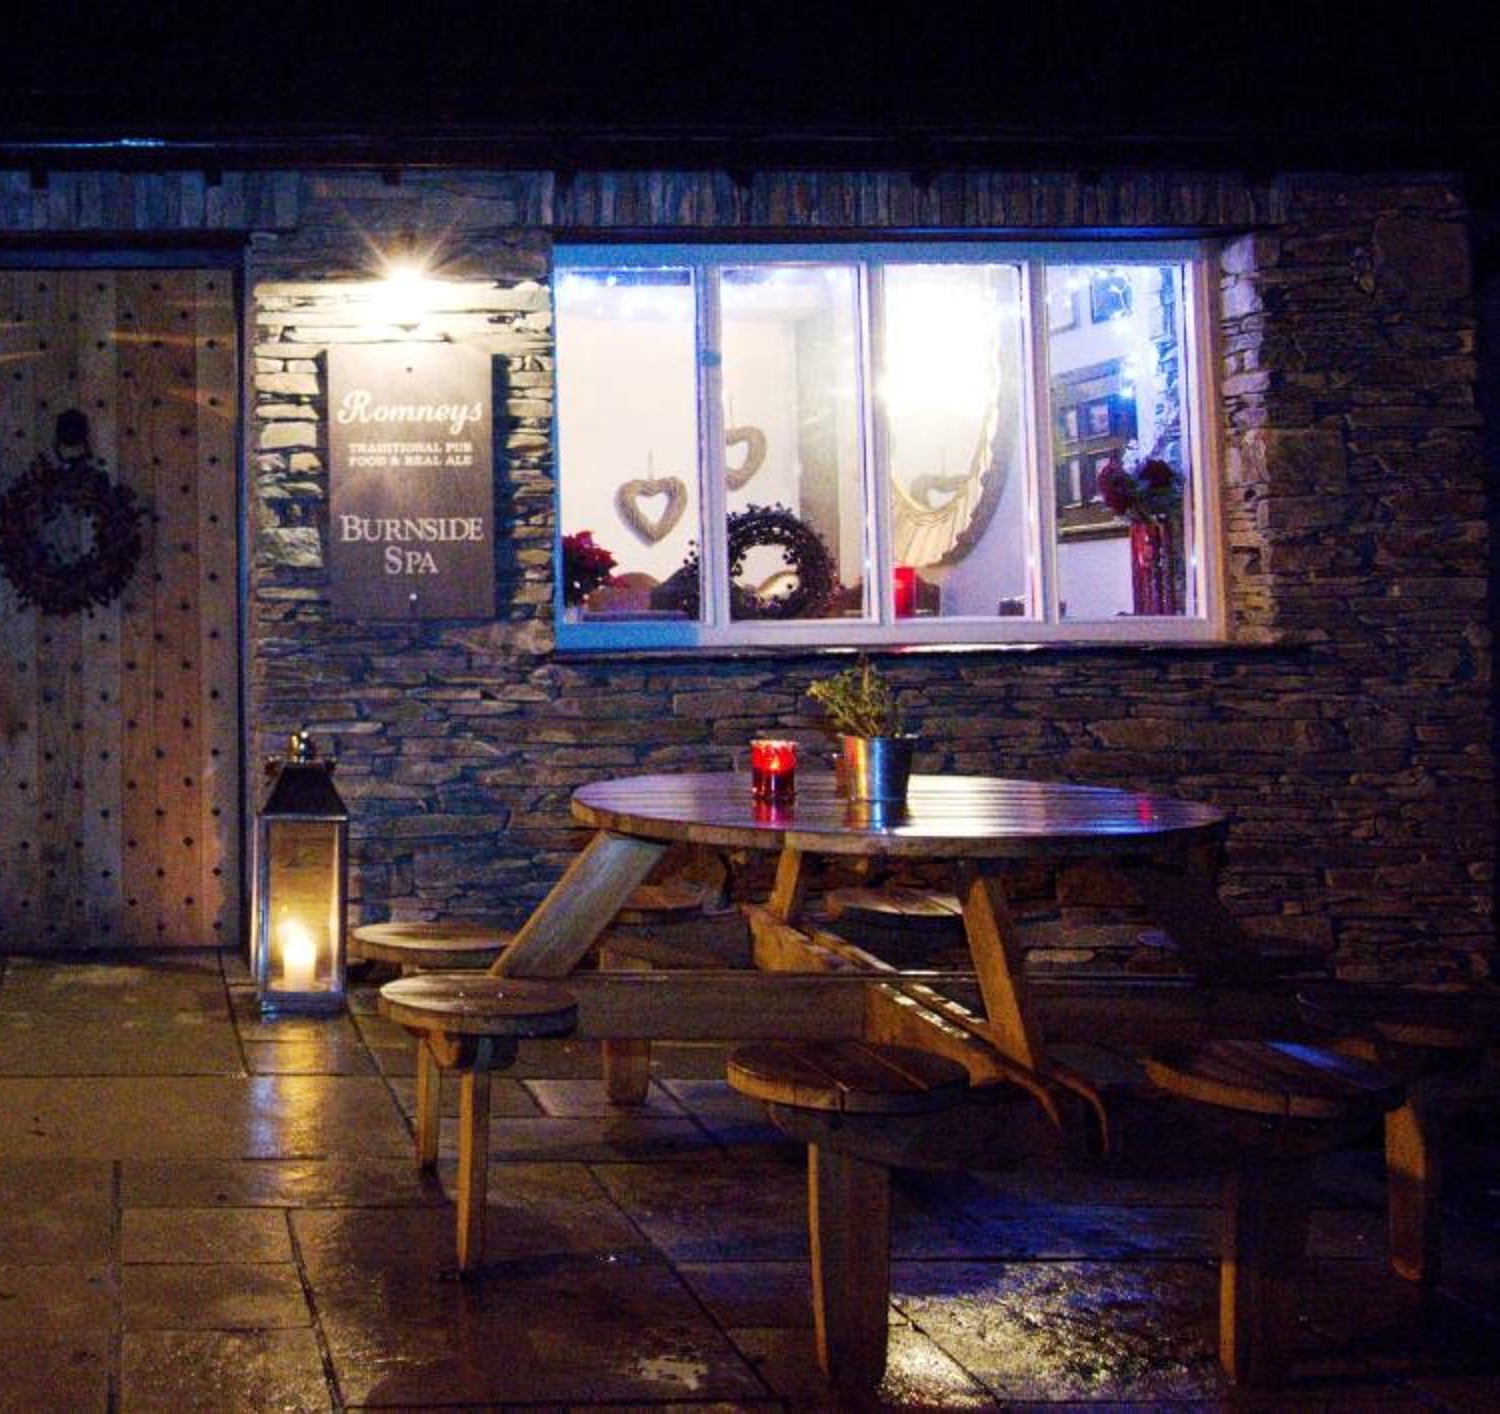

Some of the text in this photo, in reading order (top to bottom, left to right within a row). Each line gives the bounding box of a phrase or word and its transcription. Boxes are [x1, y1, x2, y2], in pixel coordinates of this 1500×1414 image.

[337, 390, 483, 434] Romneys
[348, 442, 473, 454] TRADITIONAL PUB
[348, 455, 473, 467] FOOD & REAL ALE
